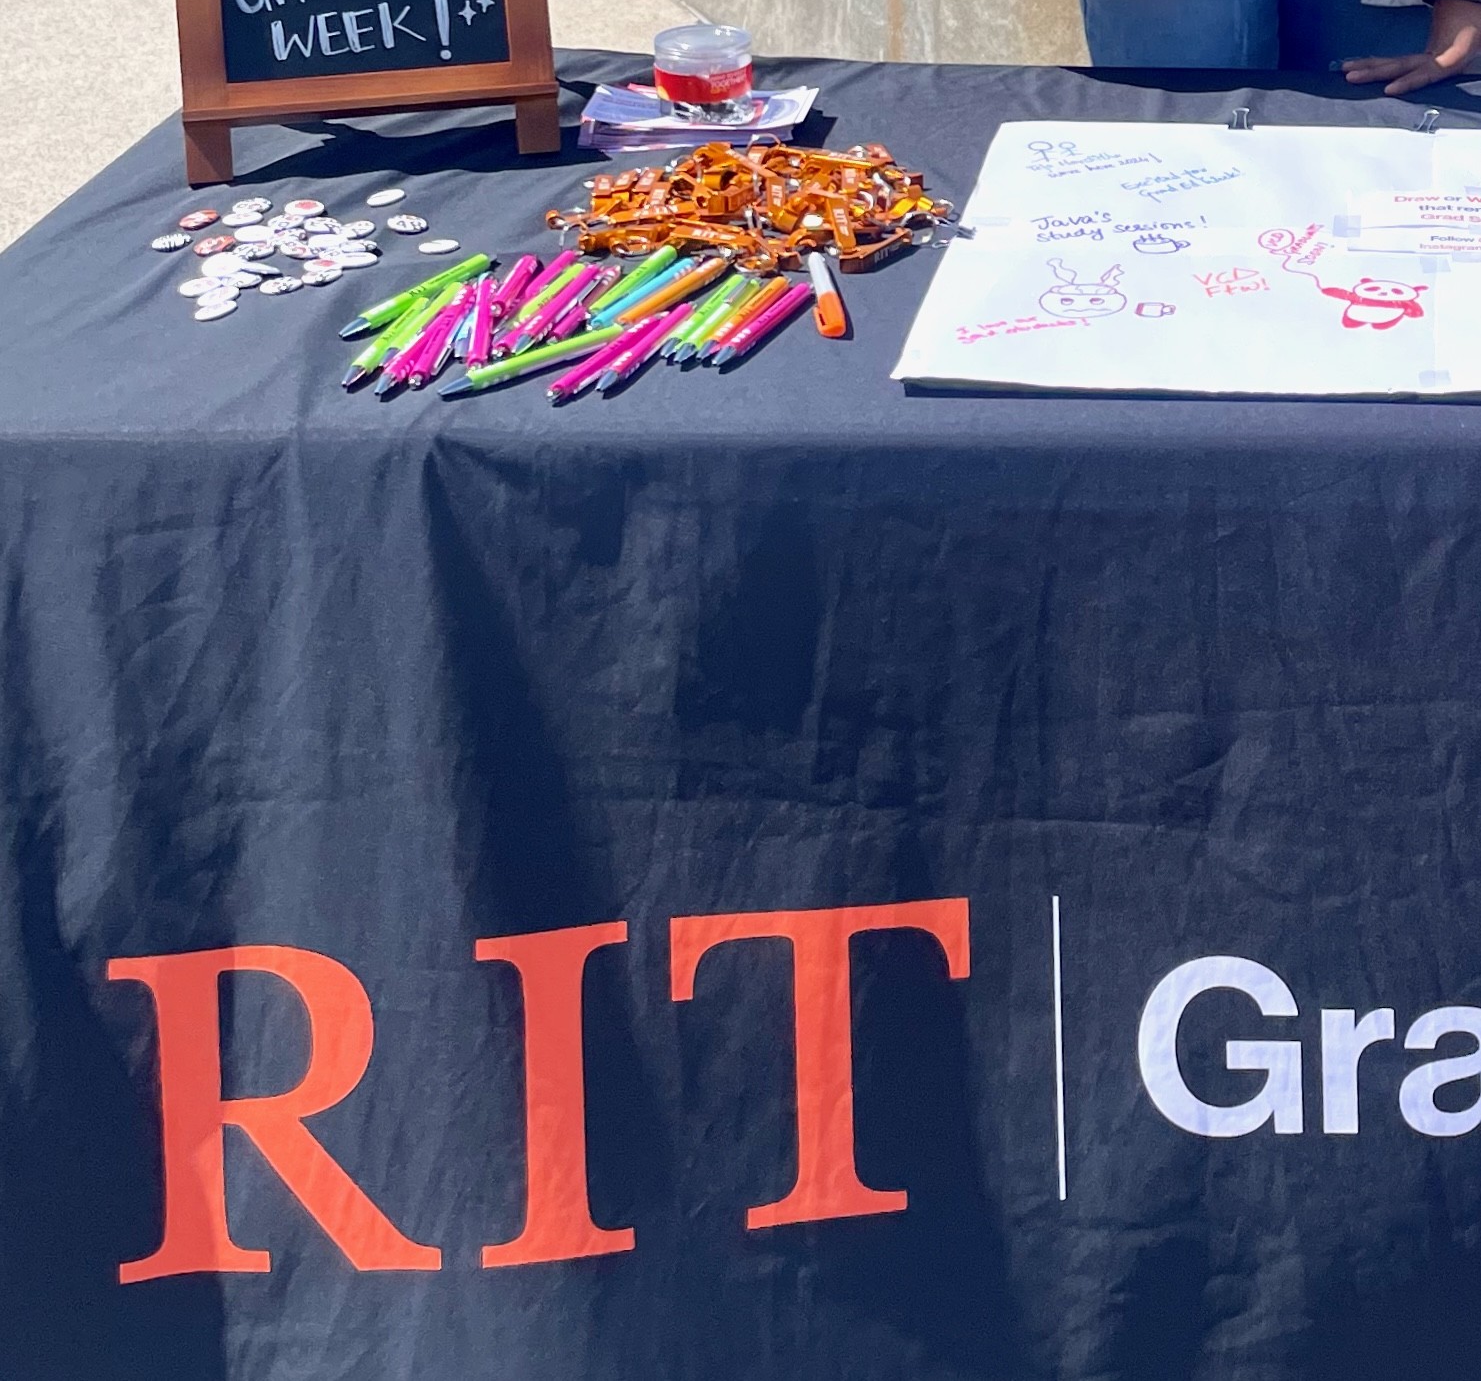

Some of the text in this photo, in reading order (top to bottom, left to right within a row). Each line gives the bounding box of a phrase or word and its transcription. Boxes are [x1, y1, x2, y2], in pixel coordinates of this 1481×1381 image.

[1394, 195, 1440, 203] Draw
[1418, 204, 1453, 212] that
[1420, 213, 1465, 222] Grad
[1430, 235, 1475, 243] Follow
[105, 896, 971, 1285] RIT
